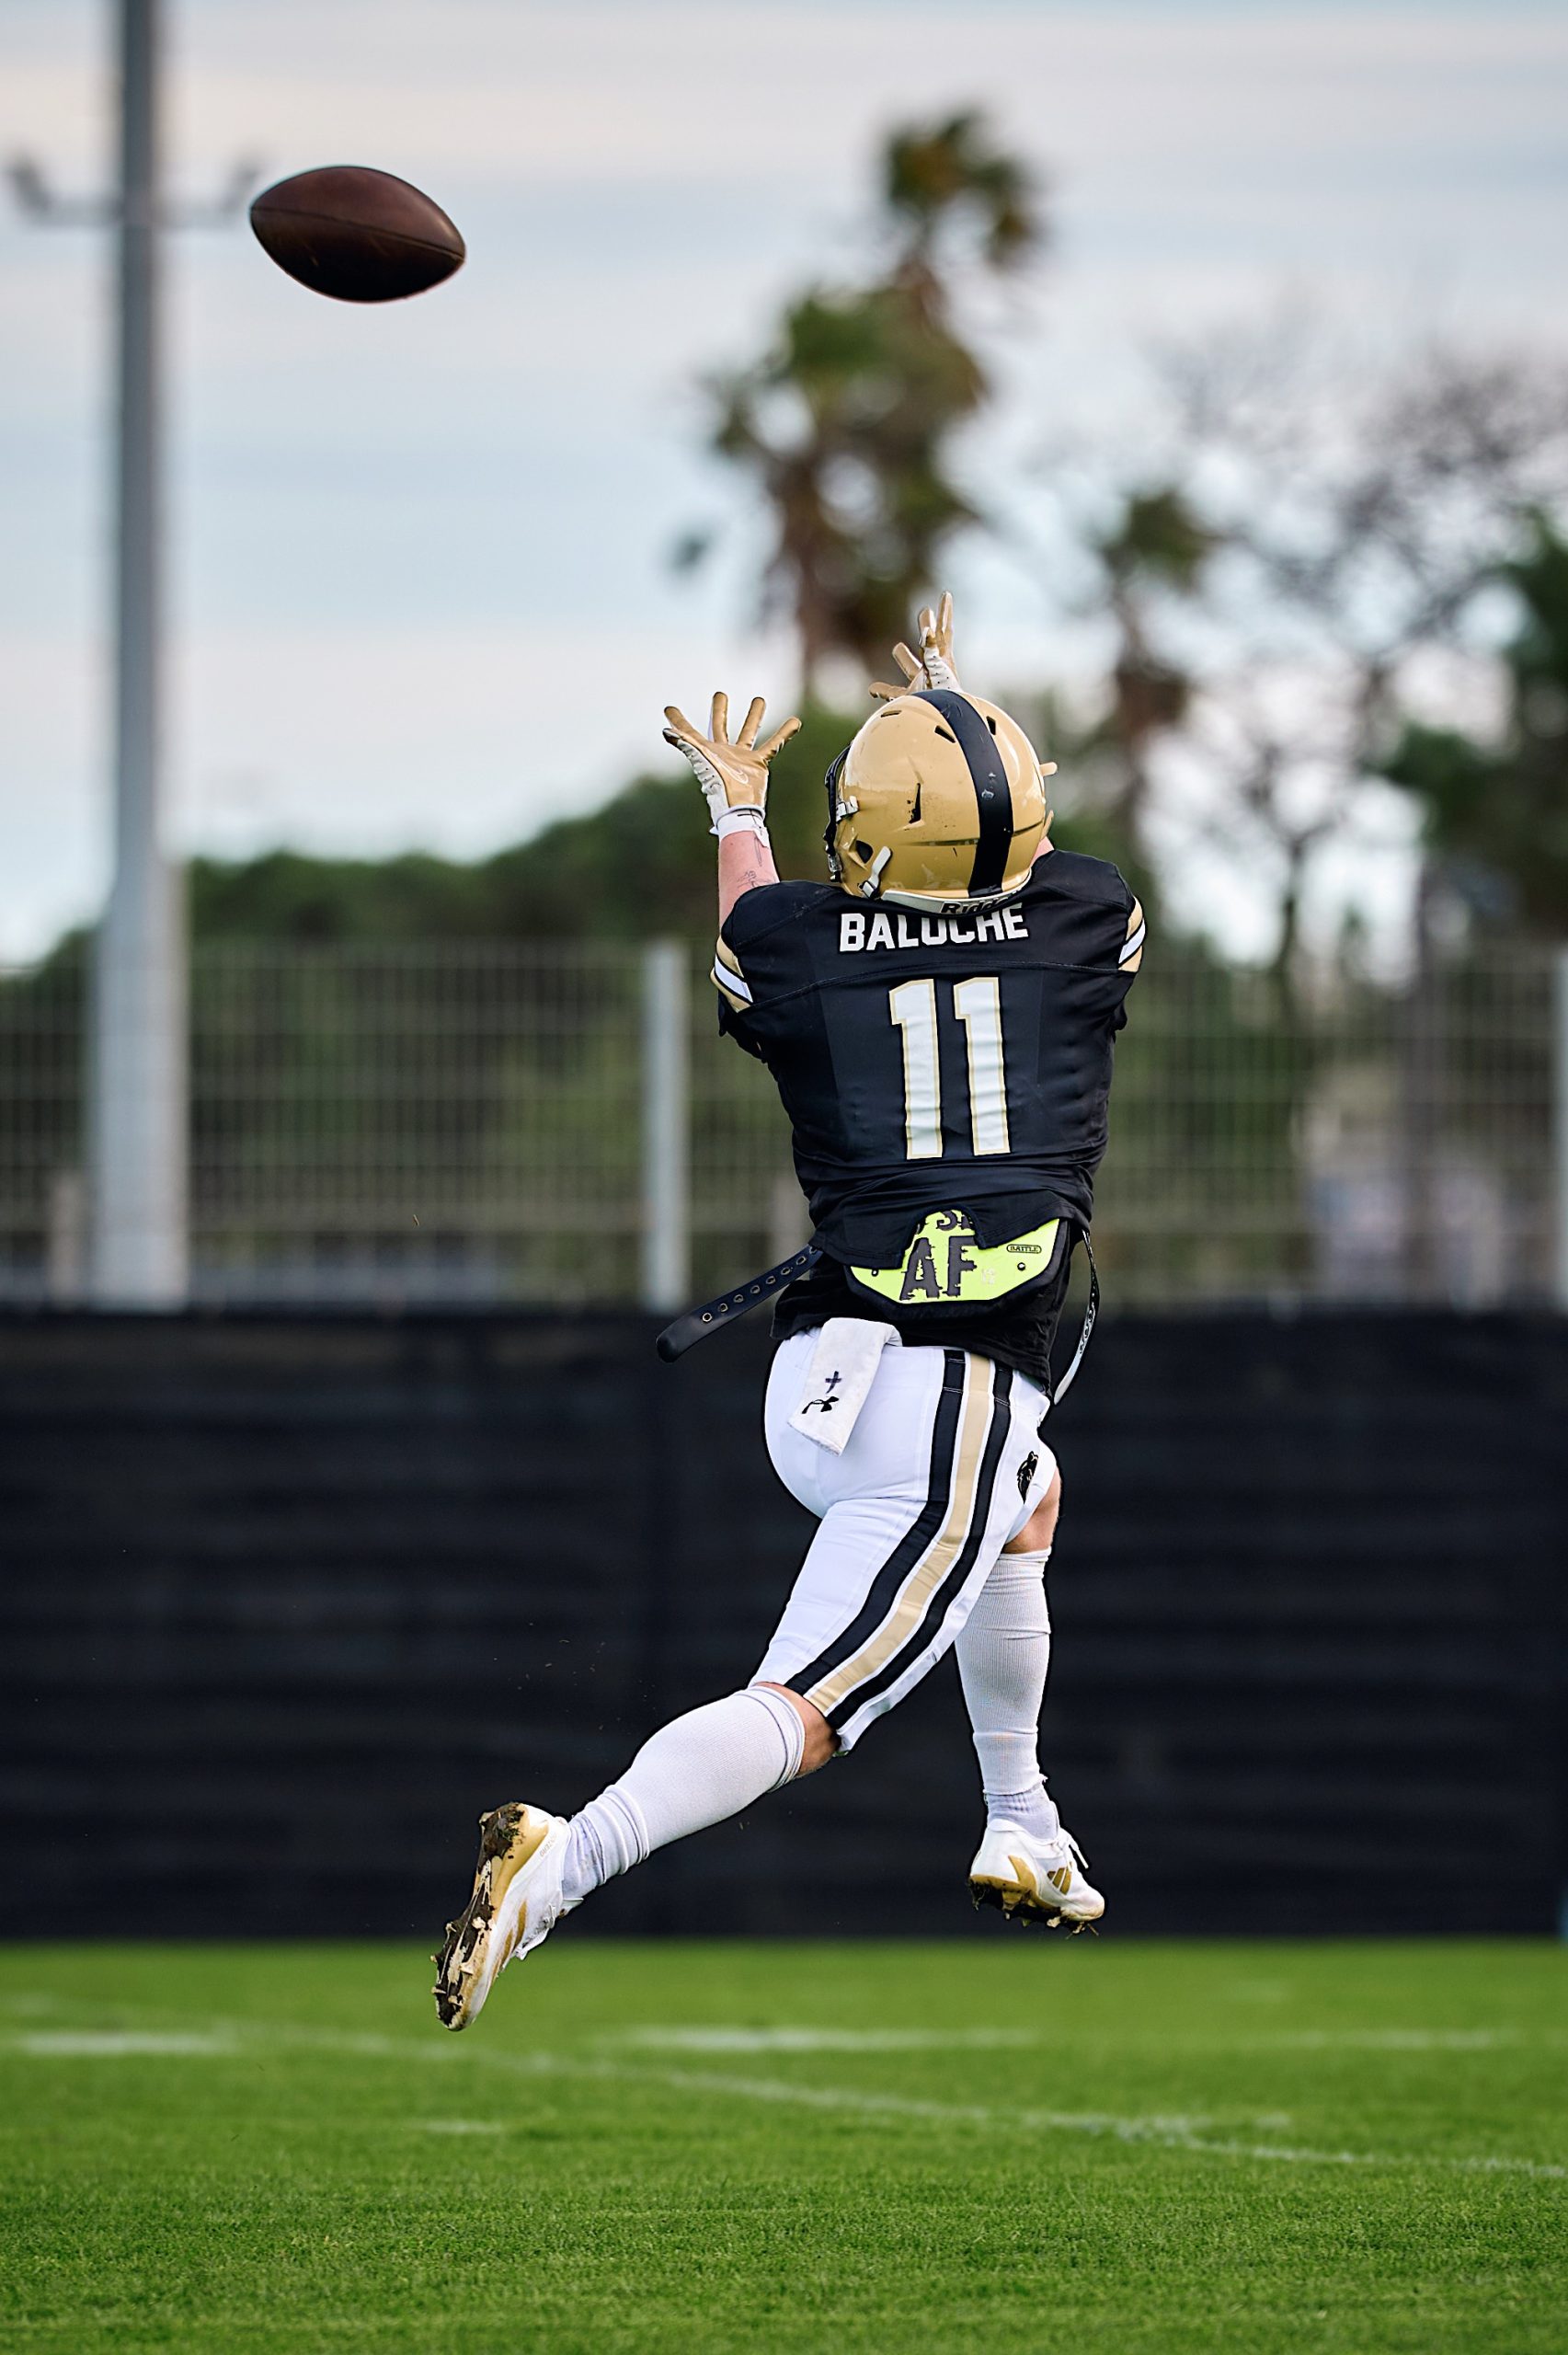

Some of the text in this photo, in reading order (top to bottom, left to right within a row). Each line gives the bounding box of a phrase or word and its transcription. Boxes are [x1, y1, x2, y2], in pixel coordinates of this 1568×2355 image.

[888, 977, 1011, 1160] 11
[898, 1236, 978, 1301] AF
[1009, 1245, 1039, 1253] BATTLE
